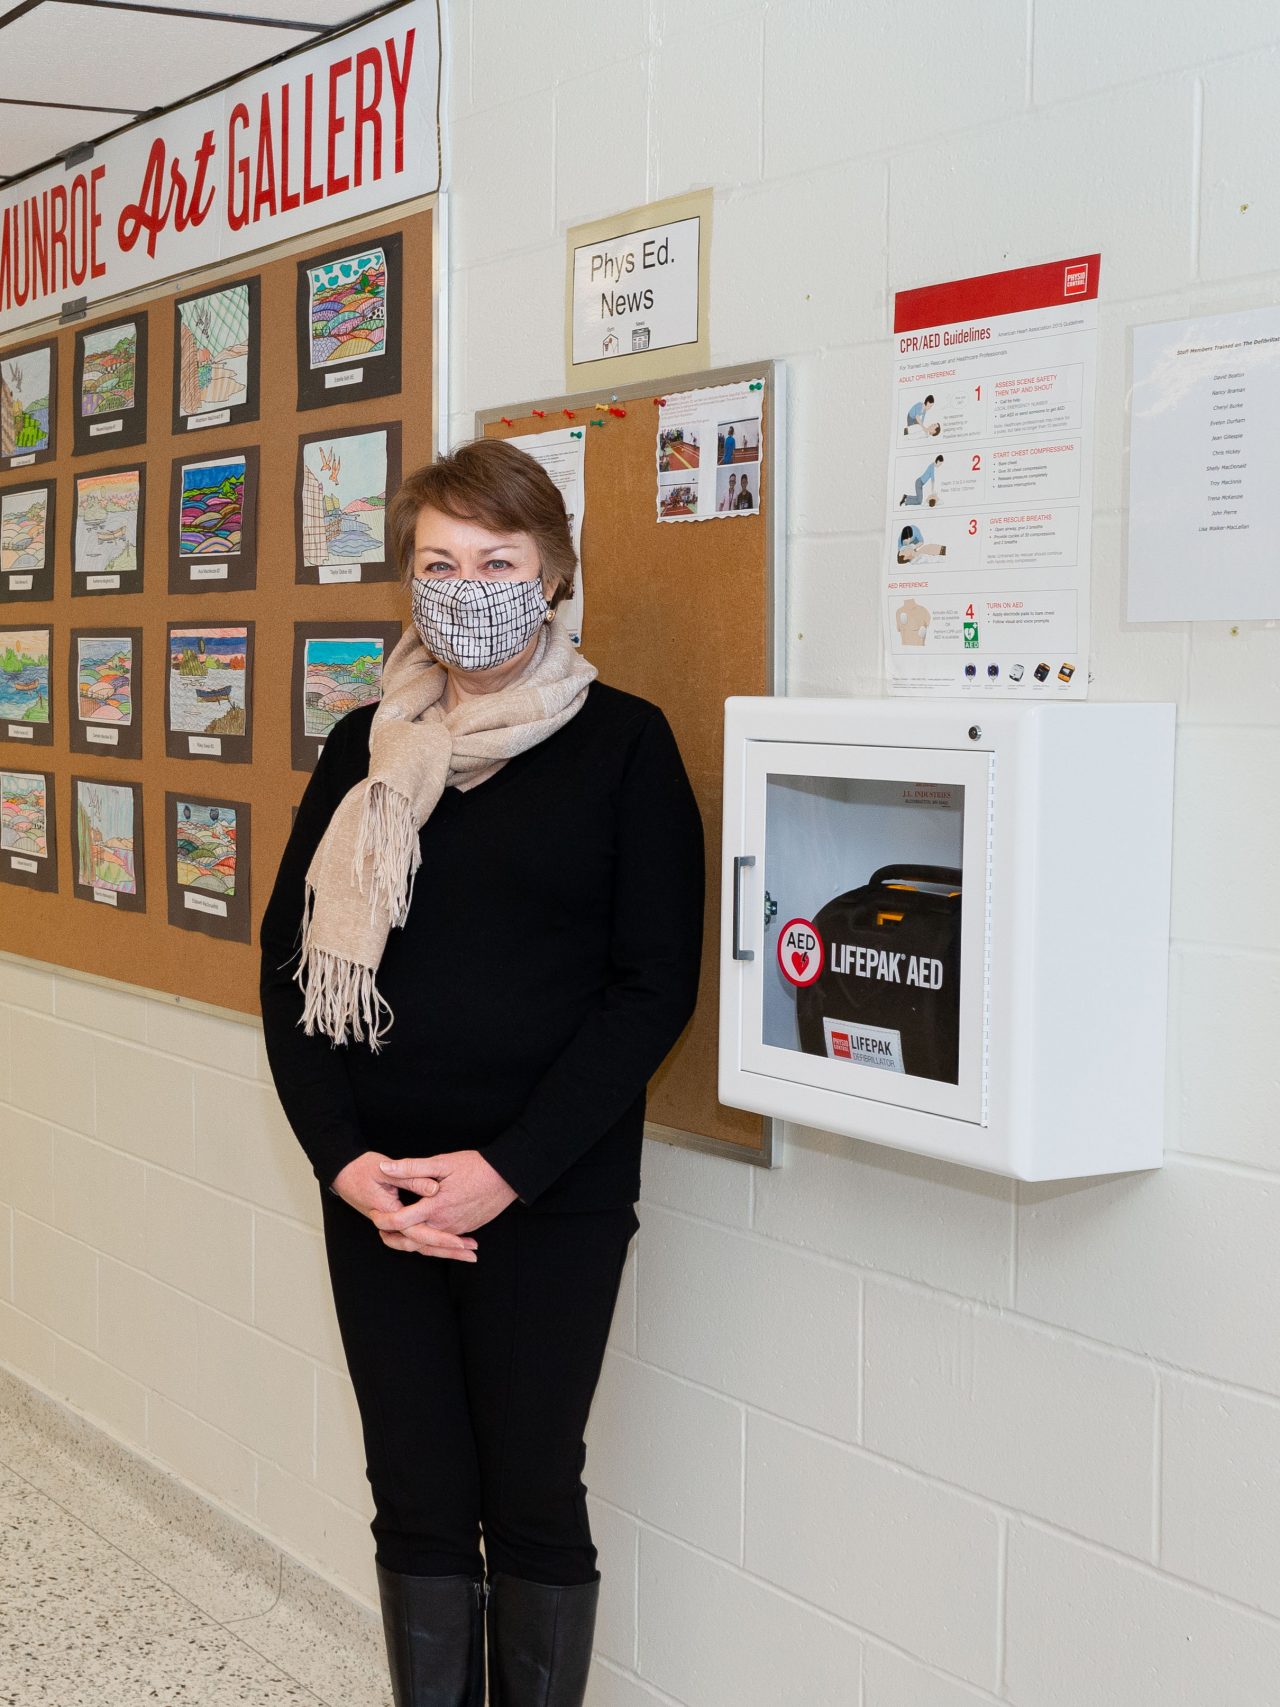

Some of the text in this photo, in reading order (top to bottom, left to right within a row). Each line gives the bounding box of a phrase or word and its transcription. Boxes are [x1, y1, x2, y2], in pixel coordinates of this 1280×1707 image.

[117, 130, 217, 258] Art
[228, 27, 417, 231] GALLERY
[590, 236, 675, 283] Phys Ed.
[600, 288, 655, 320] News
[900, 327, 992, 354] CPR/AED Guidelines
[1015, 378, 1035, 387] SCENE
[1036, 374, 1058, 384] SAFETY
[974, 384, 982, 402] 1
[994, 389, 1009, 398] THEN
[1009, 387, 1021, 396] TAP
[1021, 386, 1034, 395] AND
[993, 444, 1074, 459] START CHEST COMPRESSIONS
[971, 454, 981, 472] 2
[968, 519, 978, 536] 3
[989, 513, 1052, 525] GIVE RESCUE BREATHS
[887, 581, 929, 590] AED REFERENCE
[965, 603, 975, 620] 4
[1012, 601, 1024, 609] AED
[786, 931, 816, 951] AED
[906, 955, 944, 990] AED
[850, 1034, 893, 1057] LIFEPAK
[853, 1052, 896, 1068] DEFIBRILLATOR
